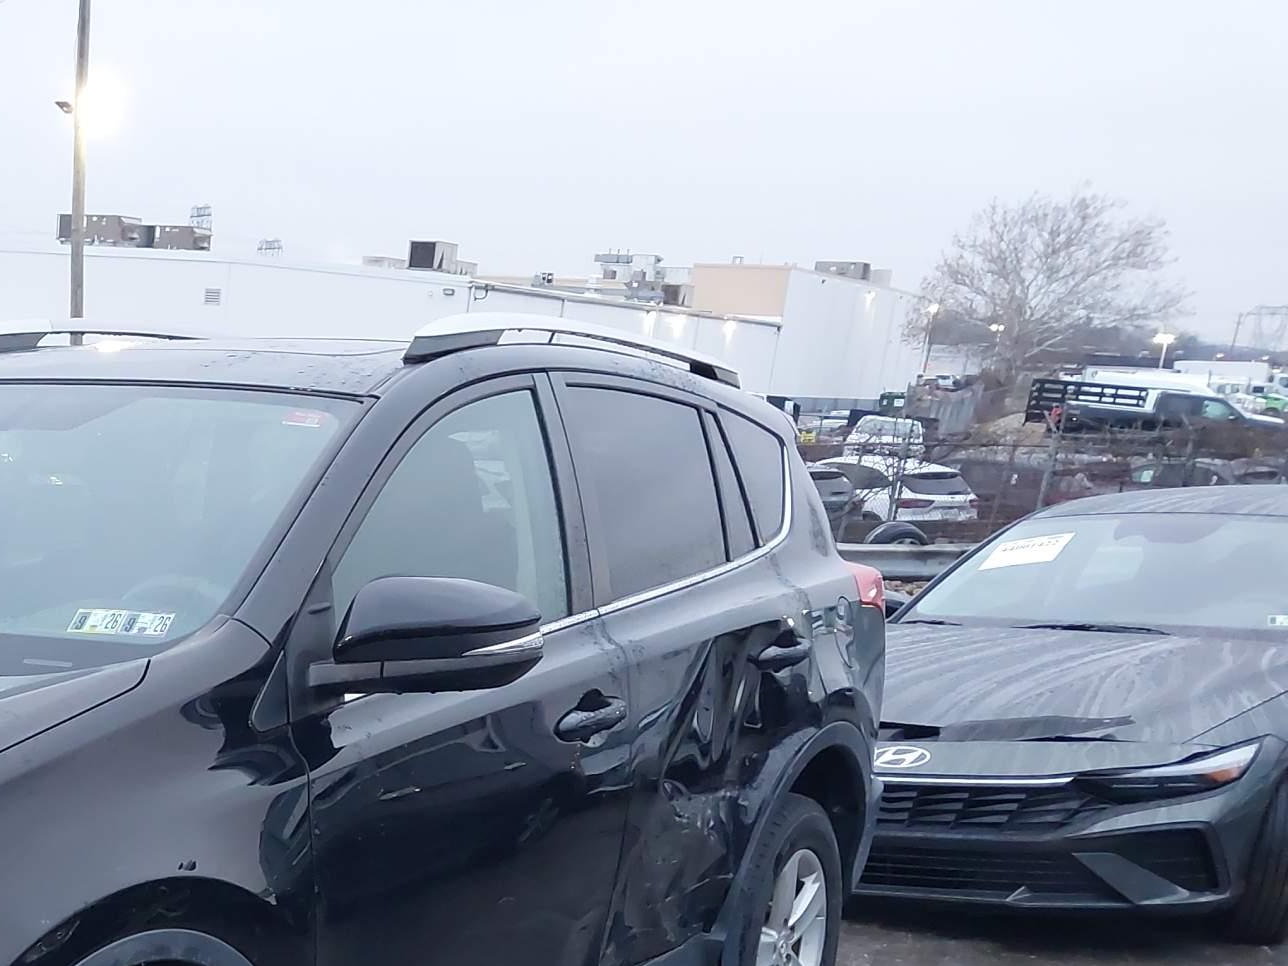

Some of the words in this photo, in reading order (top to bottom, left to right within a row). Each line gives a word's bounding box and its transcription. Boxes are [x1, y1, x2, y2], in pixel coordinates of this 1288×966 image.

[104, 613, 122, 630] 26
[124, 617, 137, 633] 9
[154, 616, 171, 633] 26
